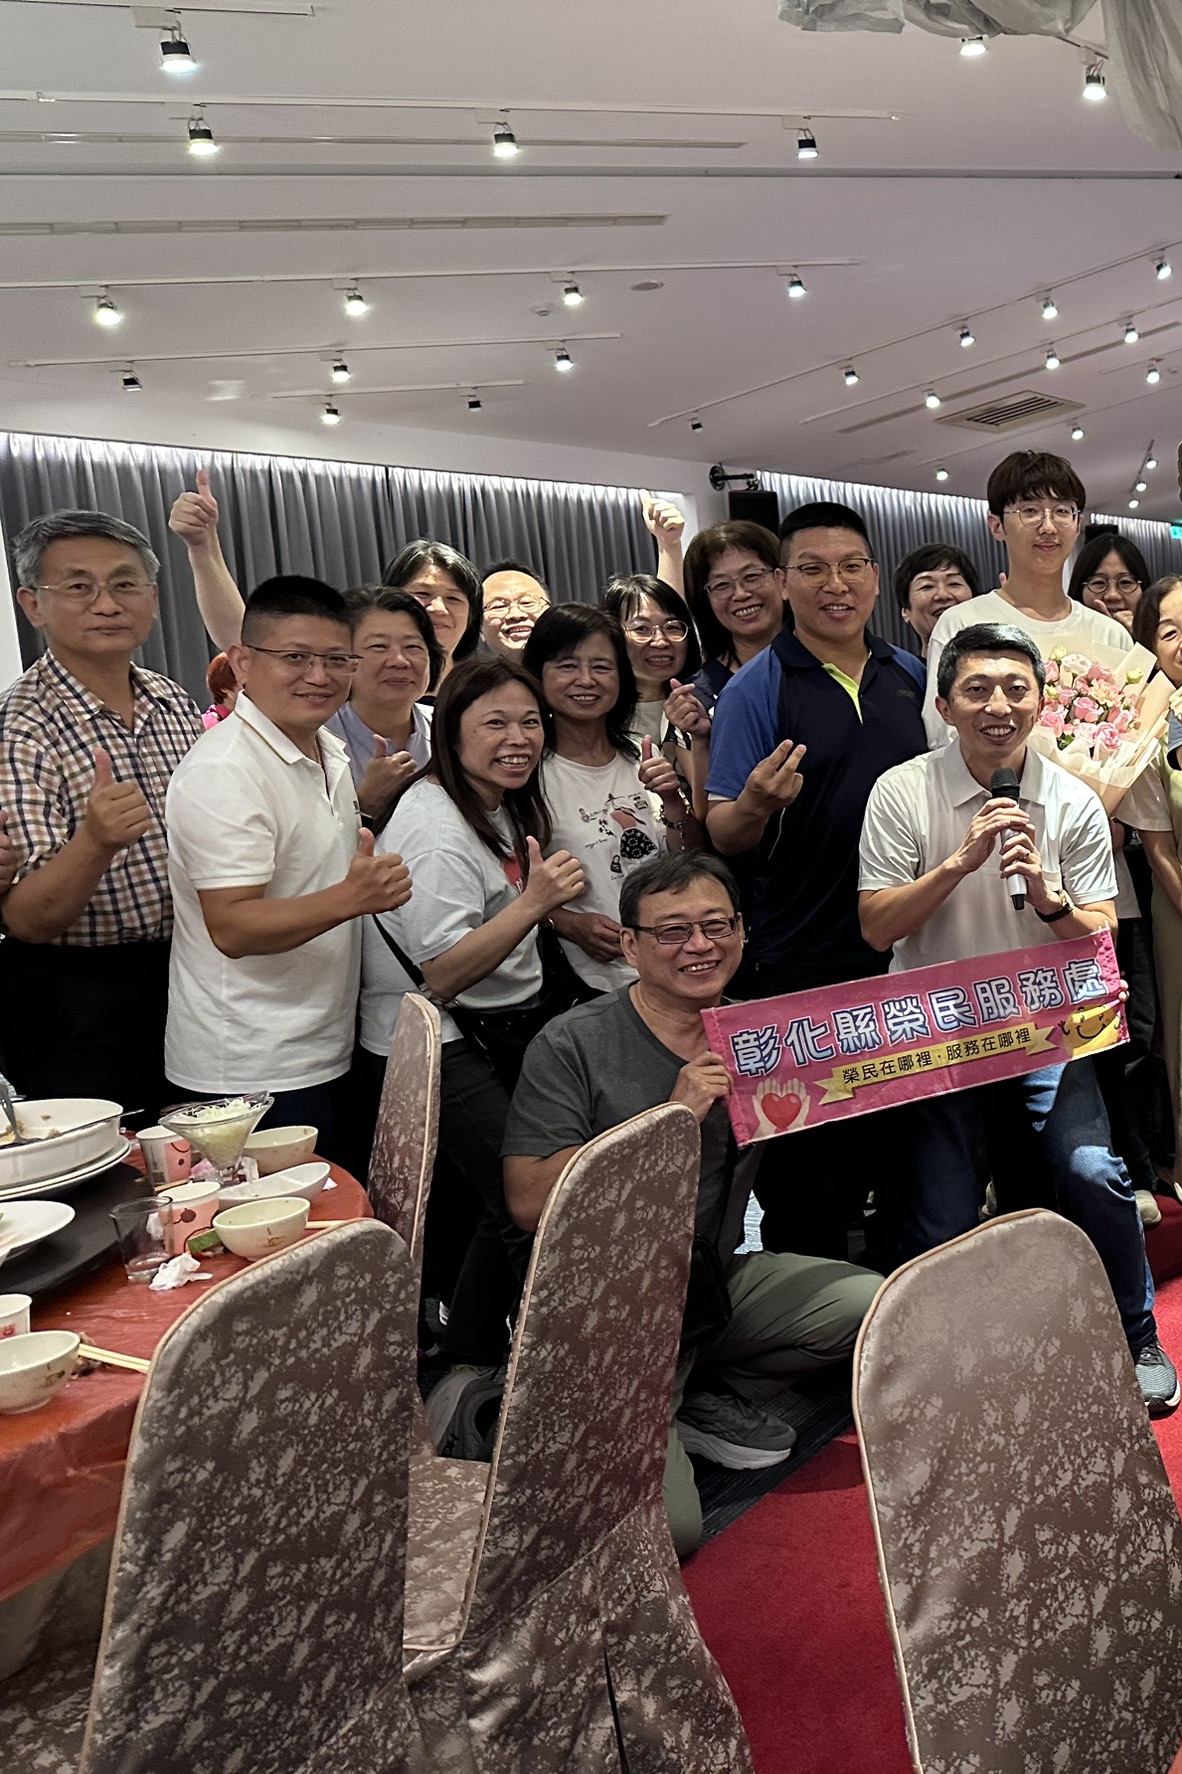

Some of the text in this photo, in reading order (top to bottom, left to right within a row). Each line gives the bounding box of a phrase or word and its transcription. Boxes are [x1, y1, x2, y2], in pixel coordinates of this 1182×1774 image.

[728, 956, 1109, 1078] 彰化縣榮民服務處
